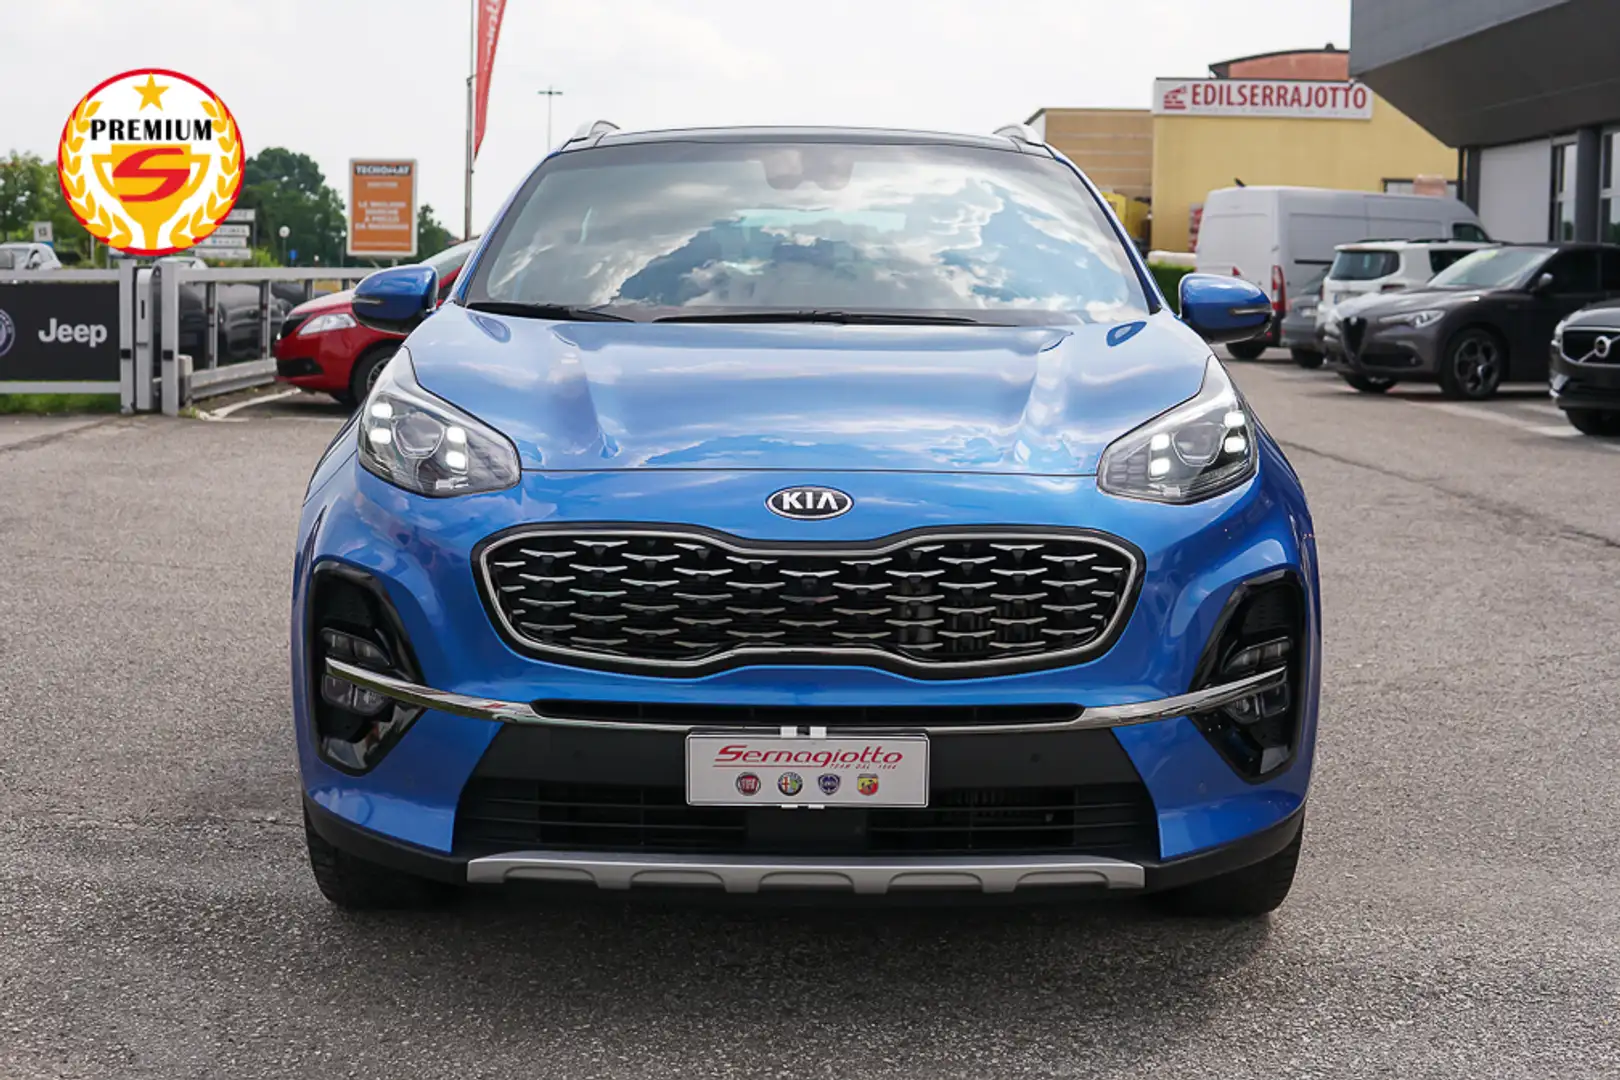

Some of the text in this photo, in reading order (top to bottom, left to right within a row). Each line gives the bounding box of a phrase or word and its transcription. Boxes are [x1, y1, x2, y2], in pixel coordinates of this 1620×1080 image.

[1191, 84, 1367, 109] EDILSERRAJOTTO
[38, 318, 108, 348] Jeep
[782, 491, 838, 510] KIA
[713, 745, 903, 768] Sernagiotto
